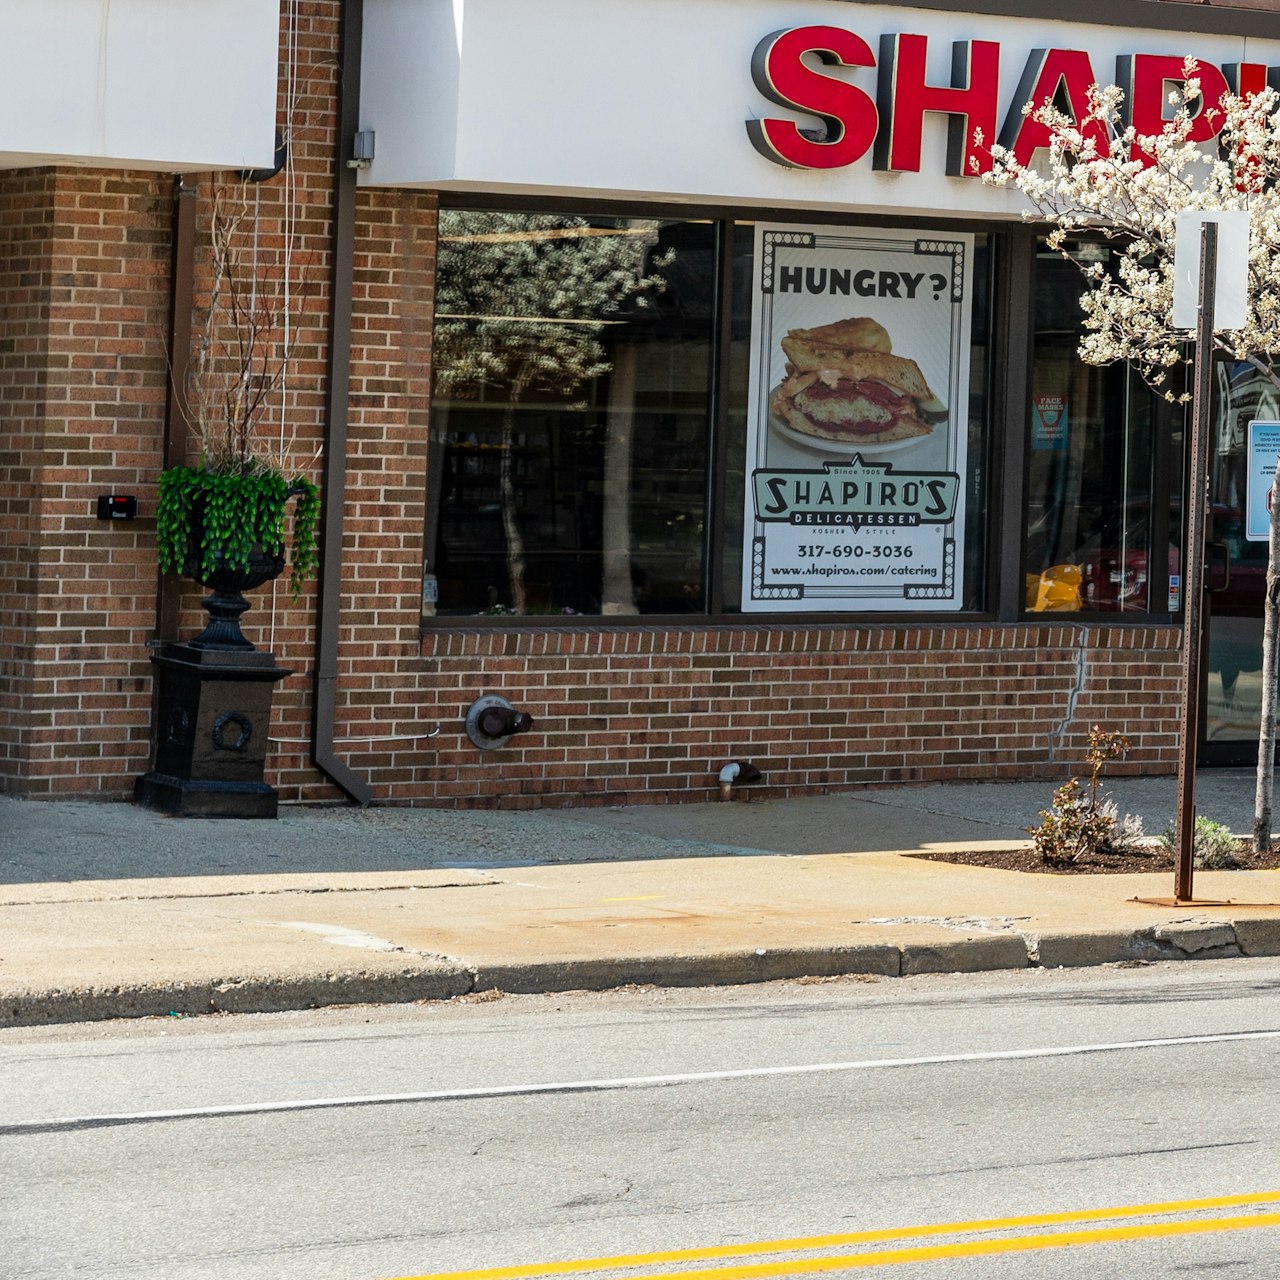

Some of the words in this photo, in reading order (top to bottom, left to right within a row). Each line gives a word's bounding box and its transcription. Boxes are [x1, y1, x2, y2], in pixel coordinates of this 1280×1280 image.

[764, 477, 947, 516] SHAPIRO'S
[795, 513, 916, 524] DELICATESSEN
[798, 545, 913, 558] 317-690-3036
[771, 563, 937, 578] www.shapiros.com/catering
